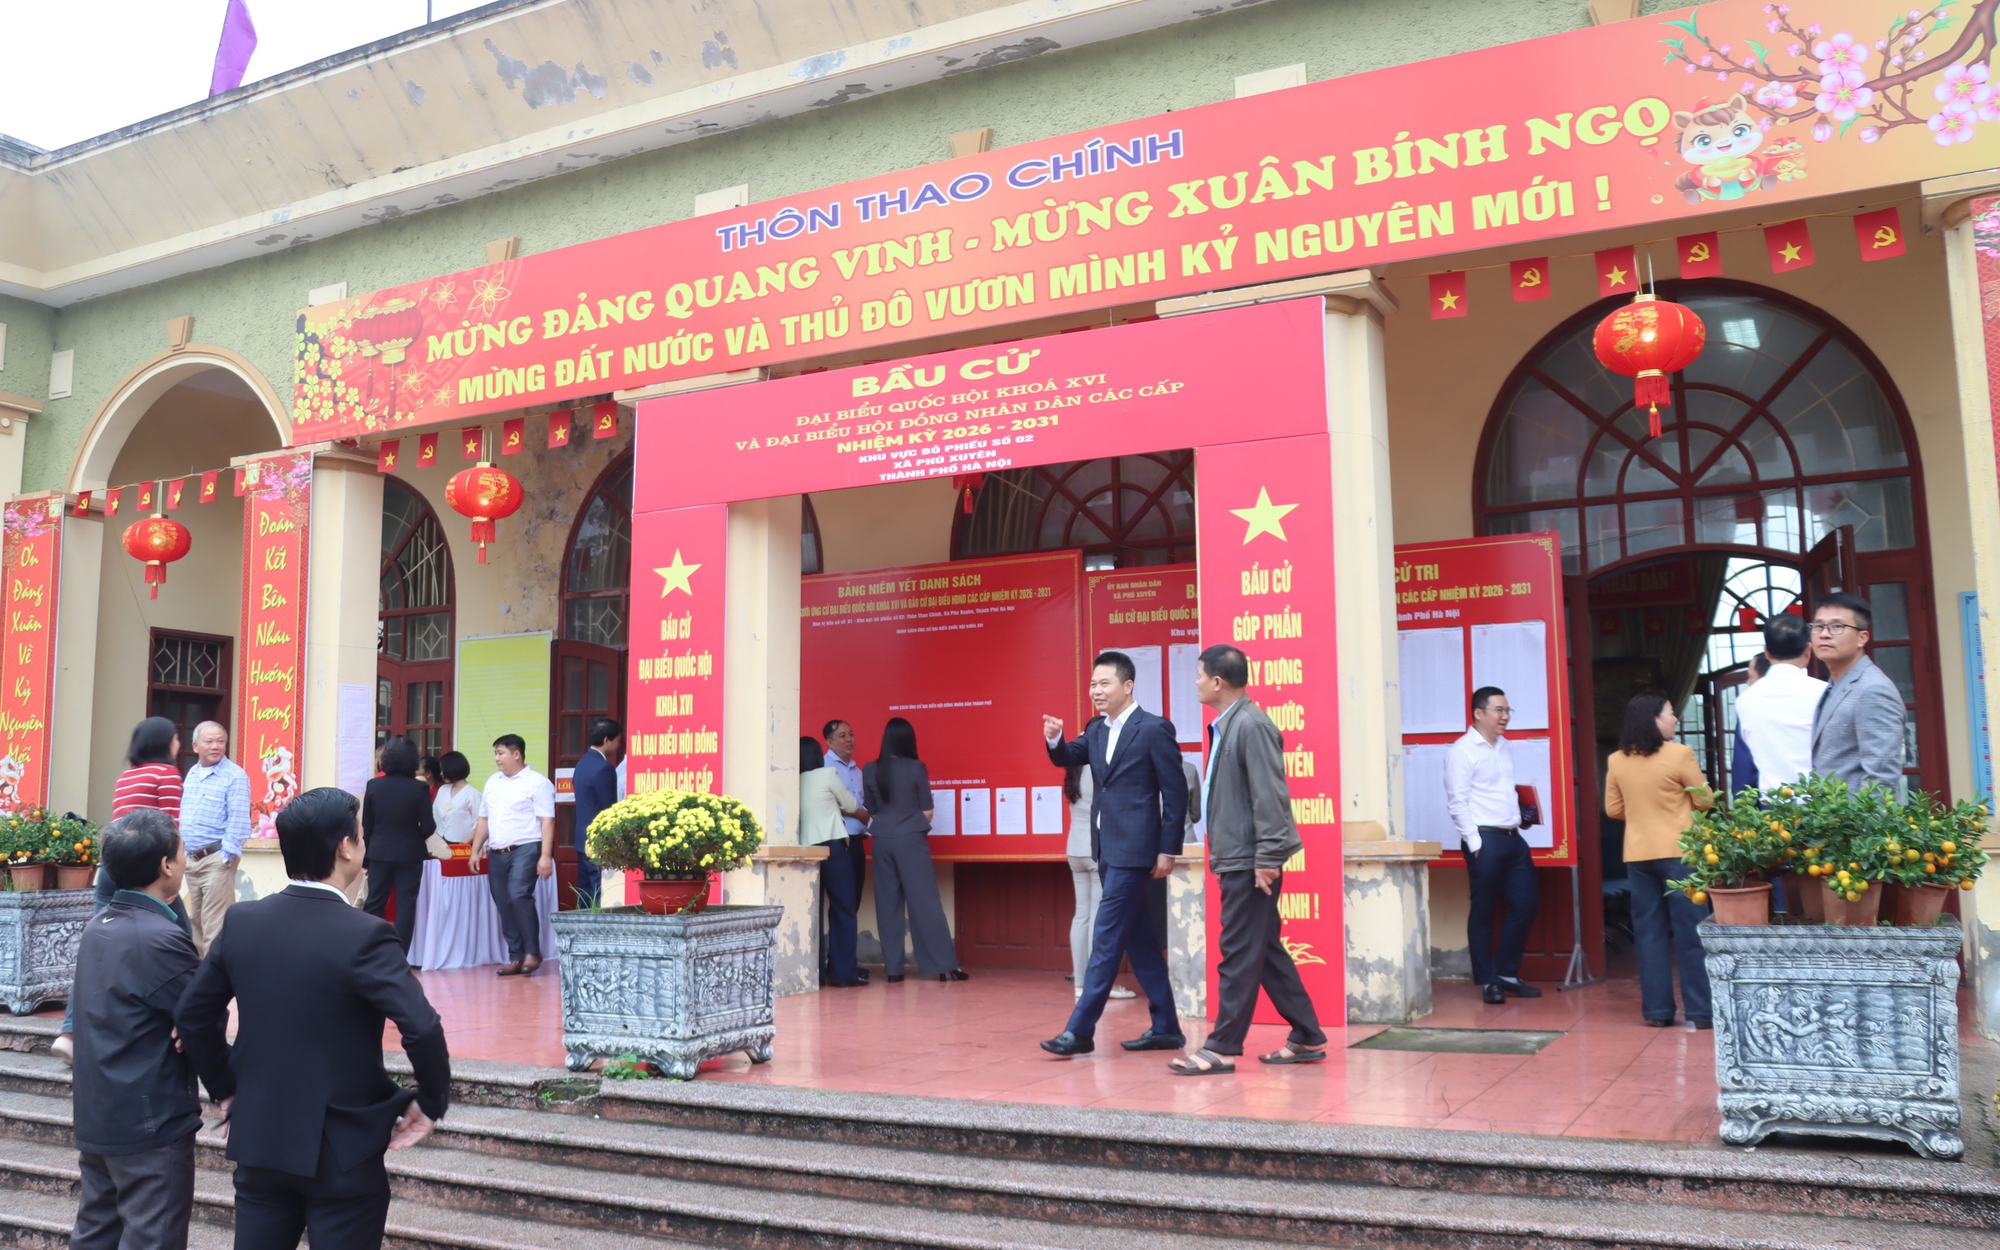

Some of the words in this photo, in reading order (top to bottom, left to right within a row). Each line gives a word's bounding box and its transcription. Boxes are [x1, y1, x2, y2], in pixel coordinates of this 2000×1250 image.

[716, 202, 841, 252] THÔN
[854, 172, 992, 223] THAO
[1006, 129, 1183, 190] CHÍNH
[426, 315, 533, 364] MỪNG
[542, 290, 655, 340] ĐẢNG
[665, 256, 821, 319] QUANG
[831, 229, 953, 280] VINH
[965, 237, 980, 249] -
[991, 190, 1154, 251] MỪNG
[1167, 155, 1337, 218] XUÂN
[1352, 124, 1510, 185] BÍNH
[1526, 97, 1671, 155] NGỌ
[458, 363, 546, 405] MỪNG
[553, 343, 614, 386] ĐẤT
[623, 328, 714, 375] NƯỚC
[724, 316, 771, 356] VÀ
[779, 295, 850, 346] THỦ
[860, 289, 914, 332] ĐÔ
[924, 271, 1035, 320] VƯƠN
[1048, 248, 1167, 299] MÌNH
[1181, 223, 1239, 277] KỶ
[1255, 200, 1455, 265] NGUYÊN
[1471, 175, 1575, 231] MỚI
[1595, 175, 1612, 211] !
[853, 364, 945, 397] BẦU
[960, 348, 1041, 380] CỬ
[736, 438, 761, 450] VÀ
[766, 434, 800, 446] ĐẠI
[806, 423, 851, 442] BIỂU
[857, 420, 893, 435] HỘI
[900, 412, 959, 429] ĐỒNG
[964, 402, 1027, 421] NHÂN
[1034, 395, 1082, 411] DÂN
[1088, 388, 1133, 403] CÁC
[1139, 379, 1184, 397] CẤP
[796, 413, 830, 426] ĐẠI
[837, 401, 883, 421] BIỂU
[889, 394, 945, 414] QUỐC
[951, 389, 989, 405] HỘI
[996, 378, 1058, 398] KHOÁ
[1065, 374, 1107, 389] XVI
[837, 434, 903, 453] NHIỆM
[909, 428, 937, 444] KỲ
[942, 424, 992, 440] 2026
[1011, 415, 1058, 431] 2031
[859, 450, 886, 463] KHU
[890, 449, 917, 459] VỰC
[922, 444, 940, 456] BỎ
[945, 438, 987, 453] PHIẾU
[992, 436, 1011, 446] SỐ
[1015, 434, 1034, 443] 02
[880, 468, 925, 481] THÀNH
[929, 463, 958, 475] PHỐ
[962, 461, 982, 471] HÀ
[986, 459, 1012, 468] NỘI
[894, 458, 912, 469] XÃ
[916, 456, 944, 466] PHÚ
[949, 450, 996, 462] XUYÊN
[259, 511, 295, 537] Đoàn
[21, 542, 39, 568] Ơn
[265, 546, 286, 571] Kết
[838, 582, 865, 597] BẢNG
[869, 581, 895, 595] NIÊM
[899, 577, 917, 592] YẾT
[920, 578, 949, 590] DANH
[952, 573, 981, 587] SÁCH
[1241, 561, 1269, 596] BẦU
[1273, 559, 1292, 594] CỬ
[1415, 564, 1439, 581] TRI
[13, 579, 43, 607] Đảng
[262, 583, 287, 611] Bên
[1402, 589, 1419, 604] CÁC
[1421, 586, 1438, 602] CẤP
[1440, 586, 1467, 602] NHIỆM
[1469, 584, 1480, 598] KỲ
[1483, 585, 1503, 597] 2026
[1511, 583, 1531, 595] 2031
[11, 611, 42, 634] Xuân
[255, 620, 290, 648] Nhau
[661, 612, 677, 640] BẦU
[680, 611, 692, 639] CỬ
[1233, 611, 1260, 641] GÓP
[1264, 604, 1302, 639] PHẦN
[18, 642, 34, 666] Về
[639, 659, 652, 684] ĐẠI
[654, 649, 672, 678] BIỂU
[674, 648, 696, 680] QUỐC
[698, 650, 712, 680] HỘI
[250, 659, 294, 692] Hướng
[1264, 657, 1303, 690] DỰNG
[15, 676, 31, 706] Kỷ
[656, 690, 678, 716] KHOÁ
[680, 694, 693, 715] XVI
[251, 696, 292, 730] Tương
[631, 730, 642, 756] VÀ
[643, 734, 657, 760] ĐẠI
[659, 725, 677, 755] BIỂU
[679, 728, 693, 759] HỘI
[695, 725, 718, 753] ĐỒNG
[635, 768, 657, 794] NHÂN
[659, 767, 676, 791] DÂN
[678, 767, 694, 792] CÁC
[696, 763, 713, 793] CẤP
[1291, 793, 1335, 824] NGHĨA
[1277, 893, 1310, 924] ẠNH
[1314, 893, 1319, 919] !
